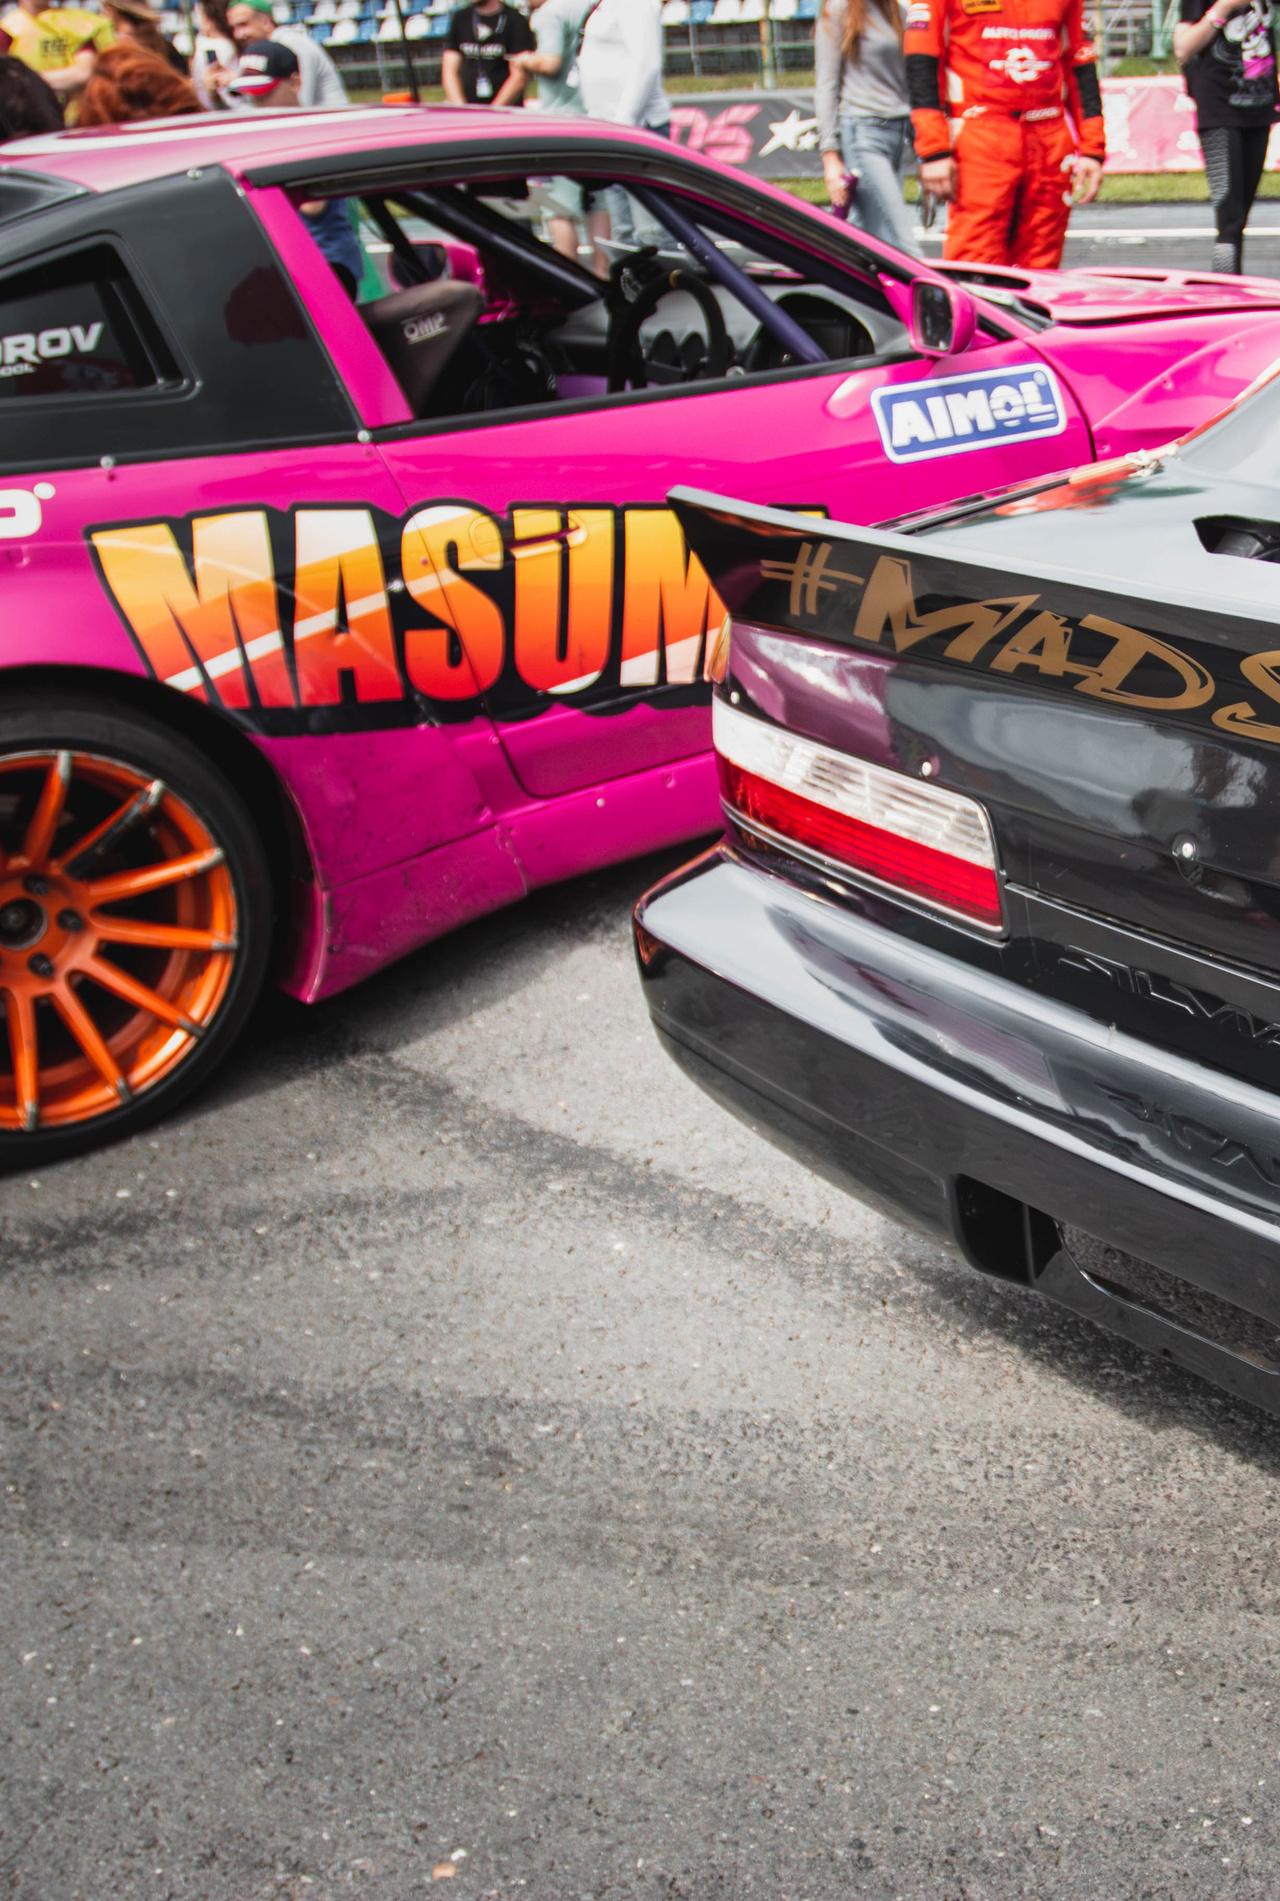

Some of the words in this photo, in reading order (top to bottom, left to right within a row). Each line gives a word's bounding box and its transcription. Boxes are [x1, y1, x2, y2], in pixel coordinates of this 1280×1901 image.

[0, 321, 104, 366] ROV
[403, 312, 446, 340] OMP
[891, 380, 1057, 448] AIMOL
[93, 505, 730, 710] MASUM
